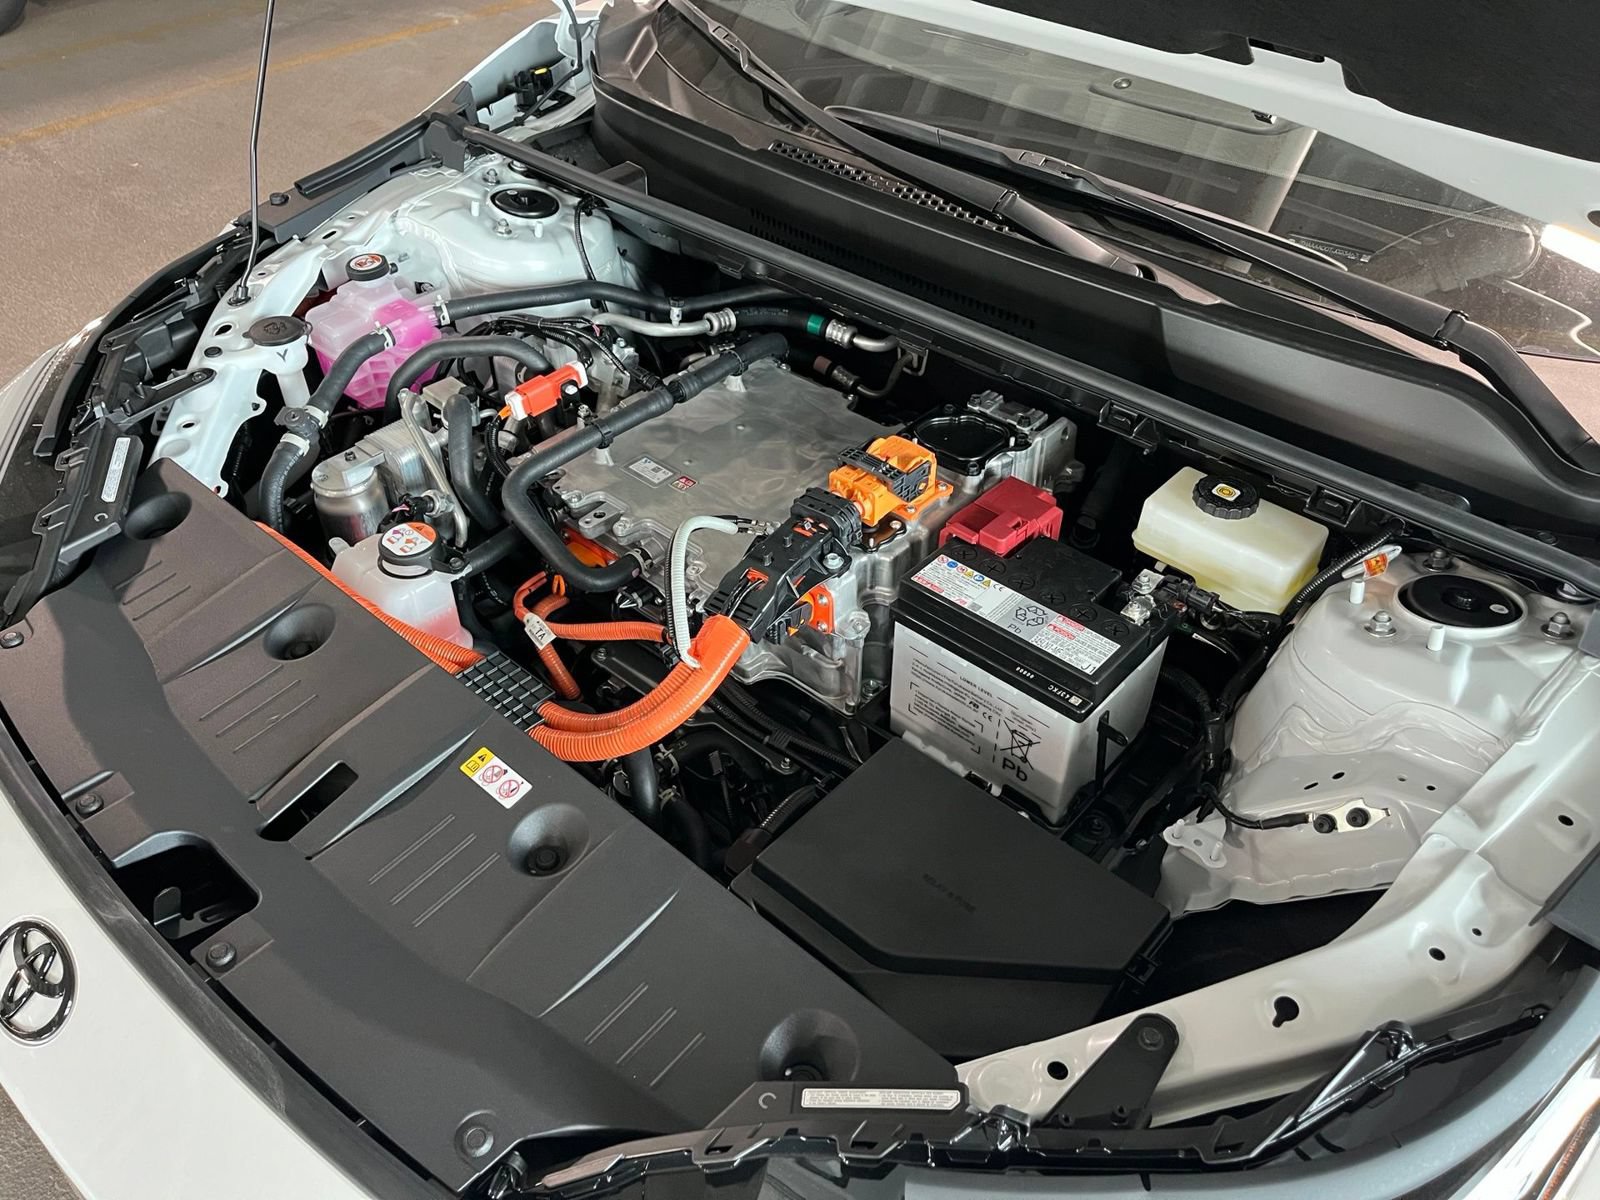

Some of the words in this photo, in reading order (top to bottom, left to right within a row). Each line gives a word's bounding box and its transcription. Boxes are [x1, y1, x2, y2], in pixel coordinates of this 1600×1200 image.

[535, 628, 546, 640] TA
[1081, 664, 1097, 674] J1
[982, 712, 993, 722] CE
[1002, 756, 1028, 782] Pb
